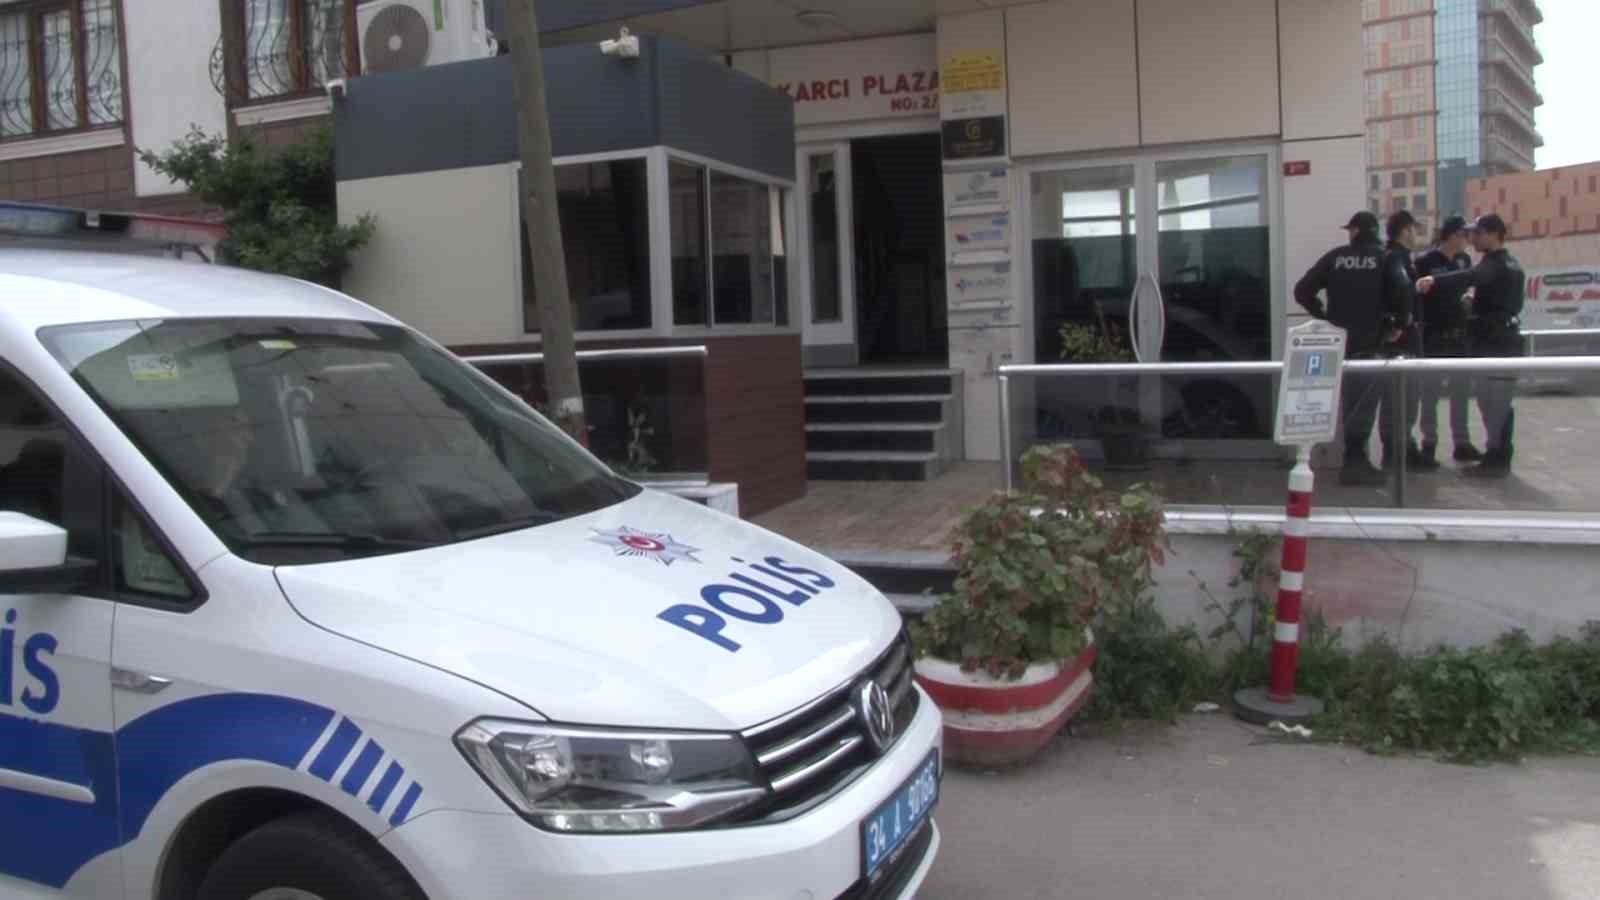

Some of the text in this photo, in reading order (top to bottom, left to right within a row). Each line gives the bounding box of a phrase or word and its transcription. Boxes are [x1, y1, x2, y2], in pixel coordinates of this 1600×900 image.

[863, 71, 938, 96] PLAZA
[869, 815, 886, 862] 34
[894, 799, 902, 839] A
